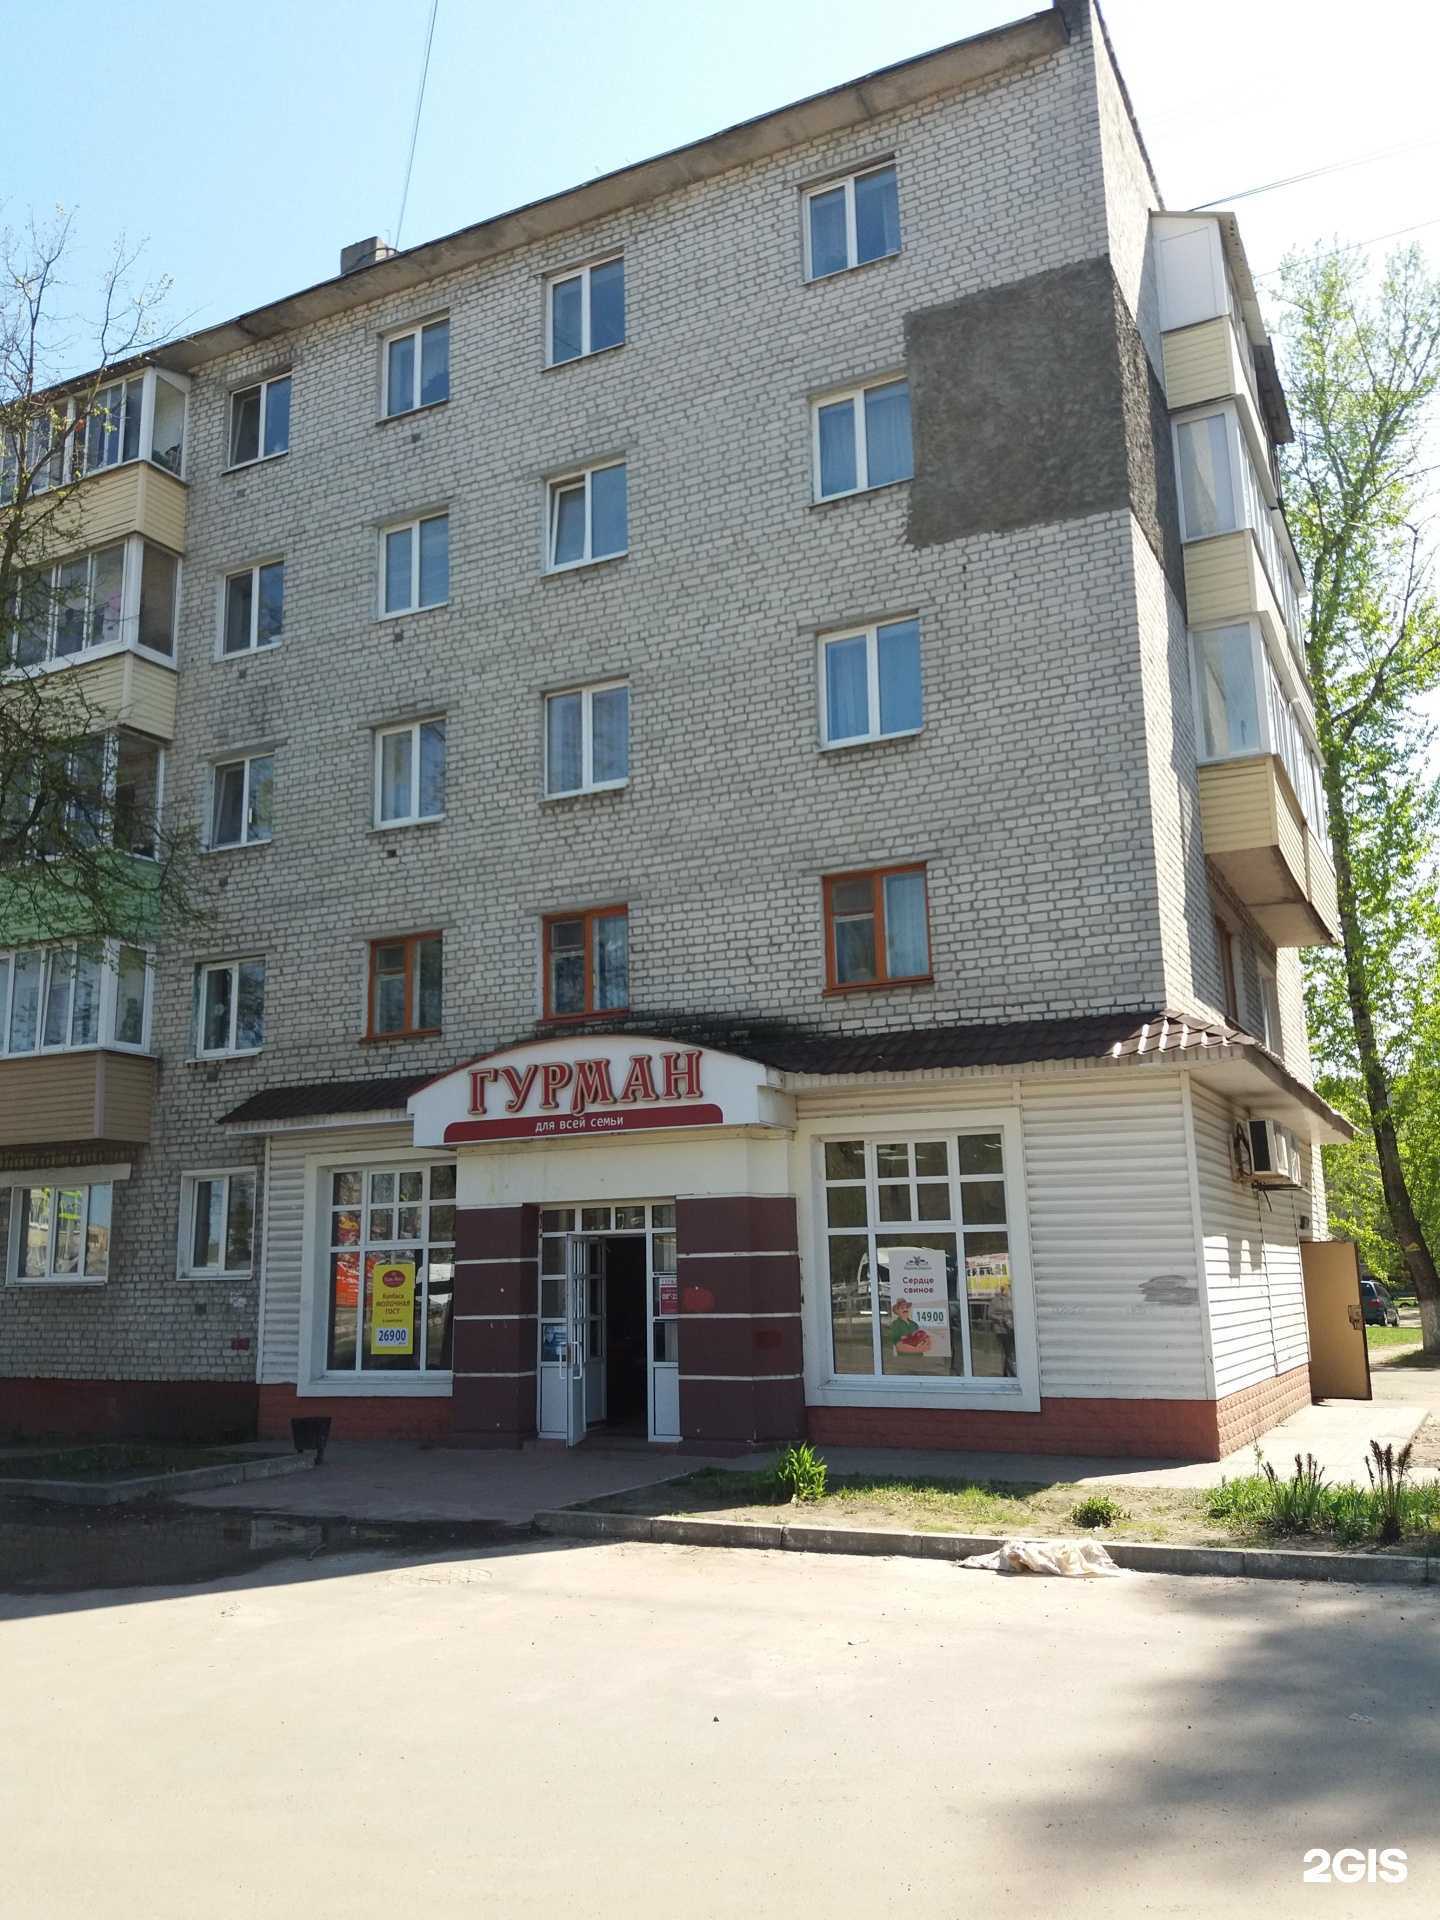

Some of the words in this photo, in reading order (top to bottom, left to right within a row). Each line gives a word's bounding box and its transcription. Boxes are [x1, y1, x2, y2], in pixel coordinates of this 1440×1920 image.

[468, 1050, 703, 1116] ГУРМАН
[535, 1120, 555, 1133] для
[559, 1117, 585, 1130] всей
[590, 1116, 624, 1128] семьи
